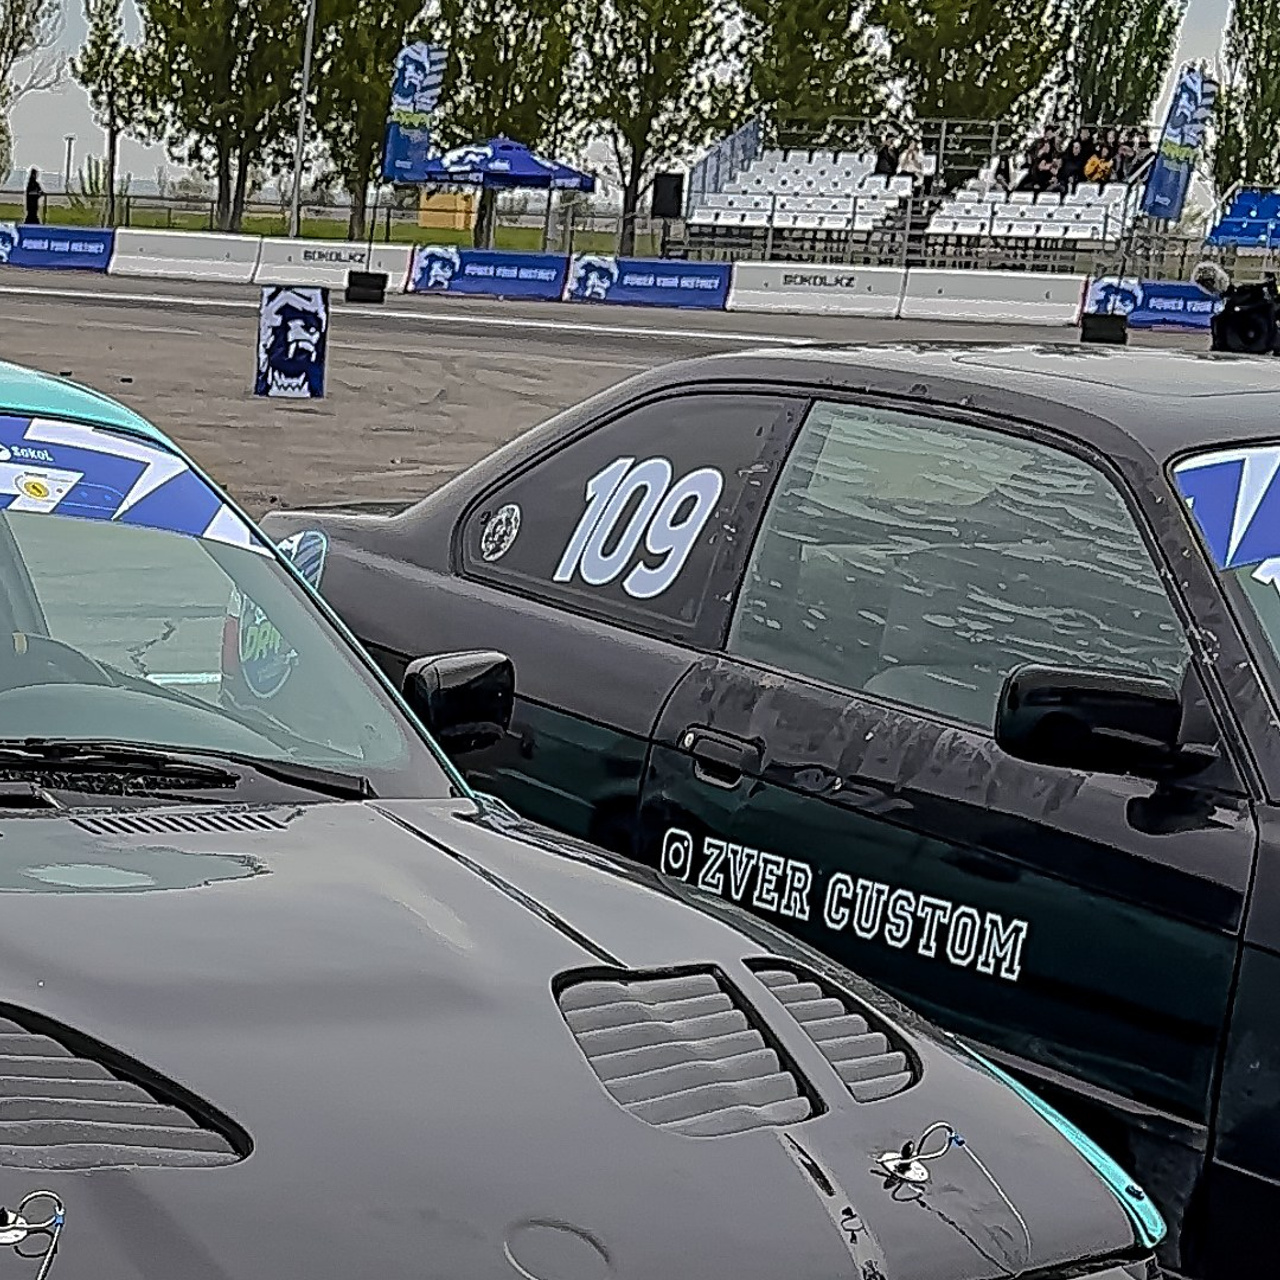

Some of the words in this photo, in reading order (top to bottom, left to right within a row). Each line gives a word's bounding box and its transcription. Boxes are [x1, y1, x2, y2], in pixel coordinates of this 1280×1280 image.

[552, 454, 724, 600] 109
[697, 836, 813, 922] ZVER
[822, 872, 1029, 982] CUSTOM
